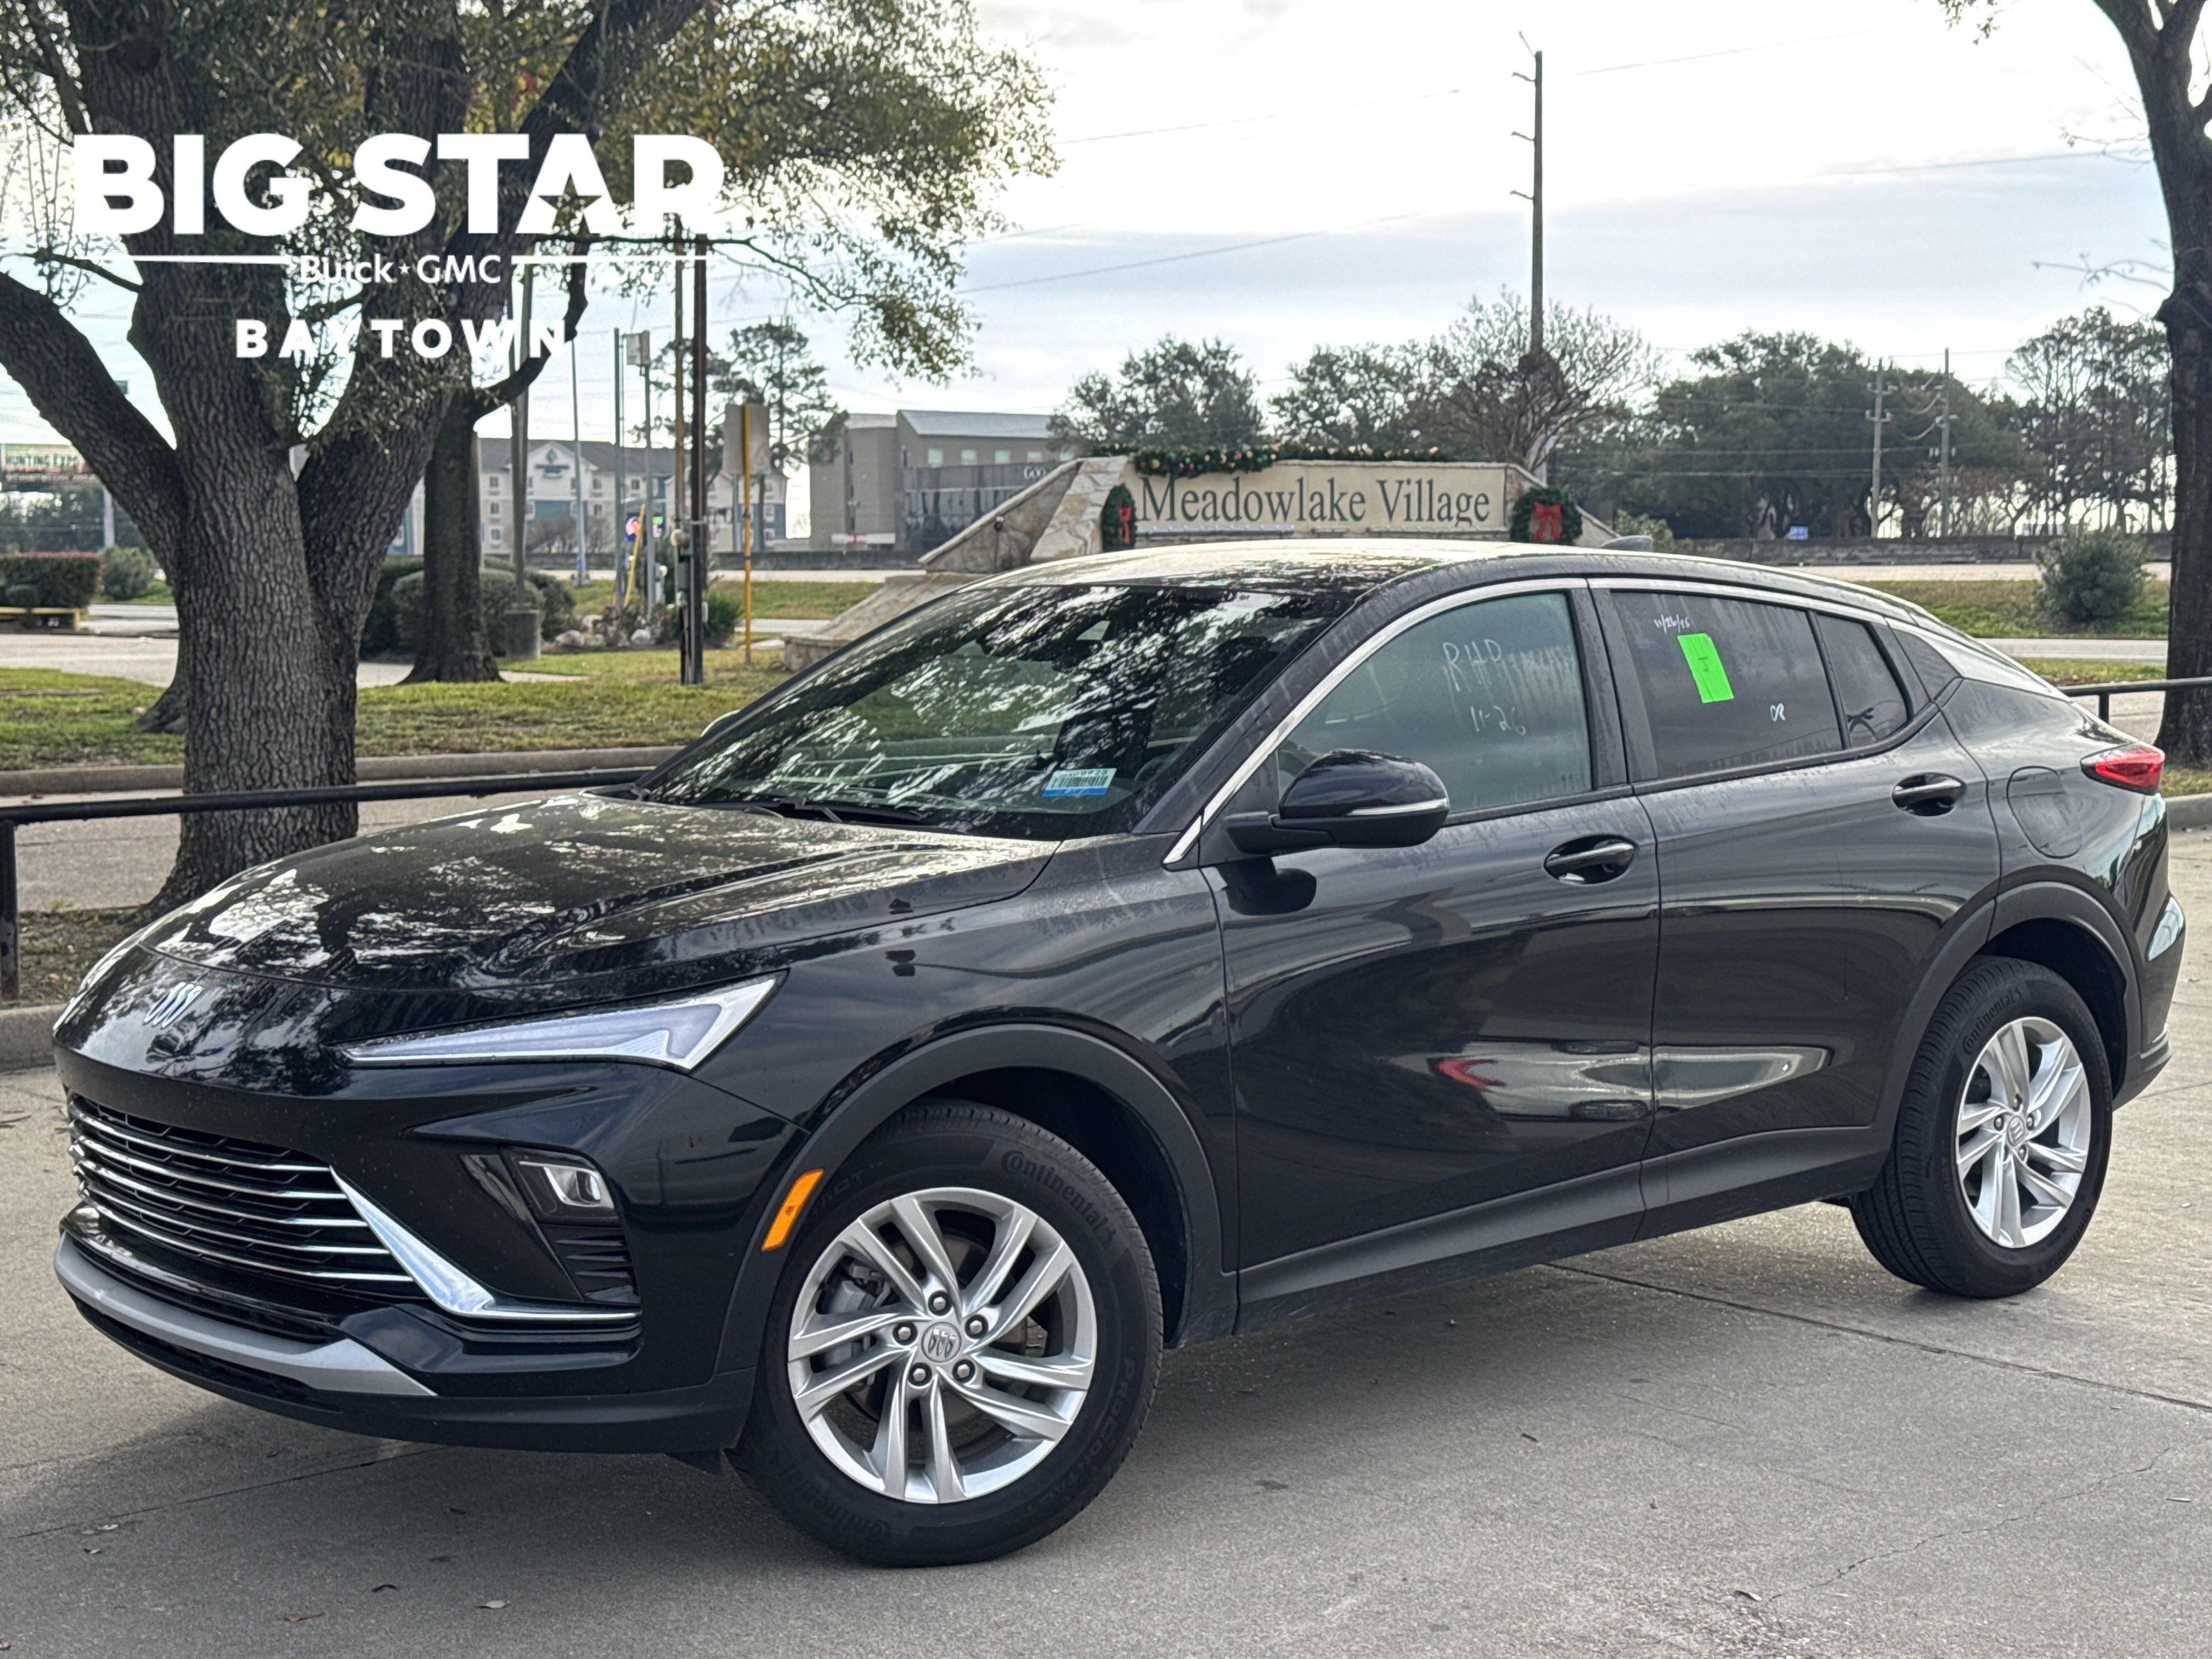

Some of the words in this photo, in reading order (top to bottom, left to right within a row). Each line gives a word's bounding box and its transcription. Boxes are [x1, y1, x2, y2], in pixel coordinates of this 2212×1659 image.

[1138, 476, 1366, 522] Meadowlake
[1376, 478, 1490, 527] Village
[1962, 990, 2015, 1056] Continental
[1001, 1149, 1108, 1232] Continental
